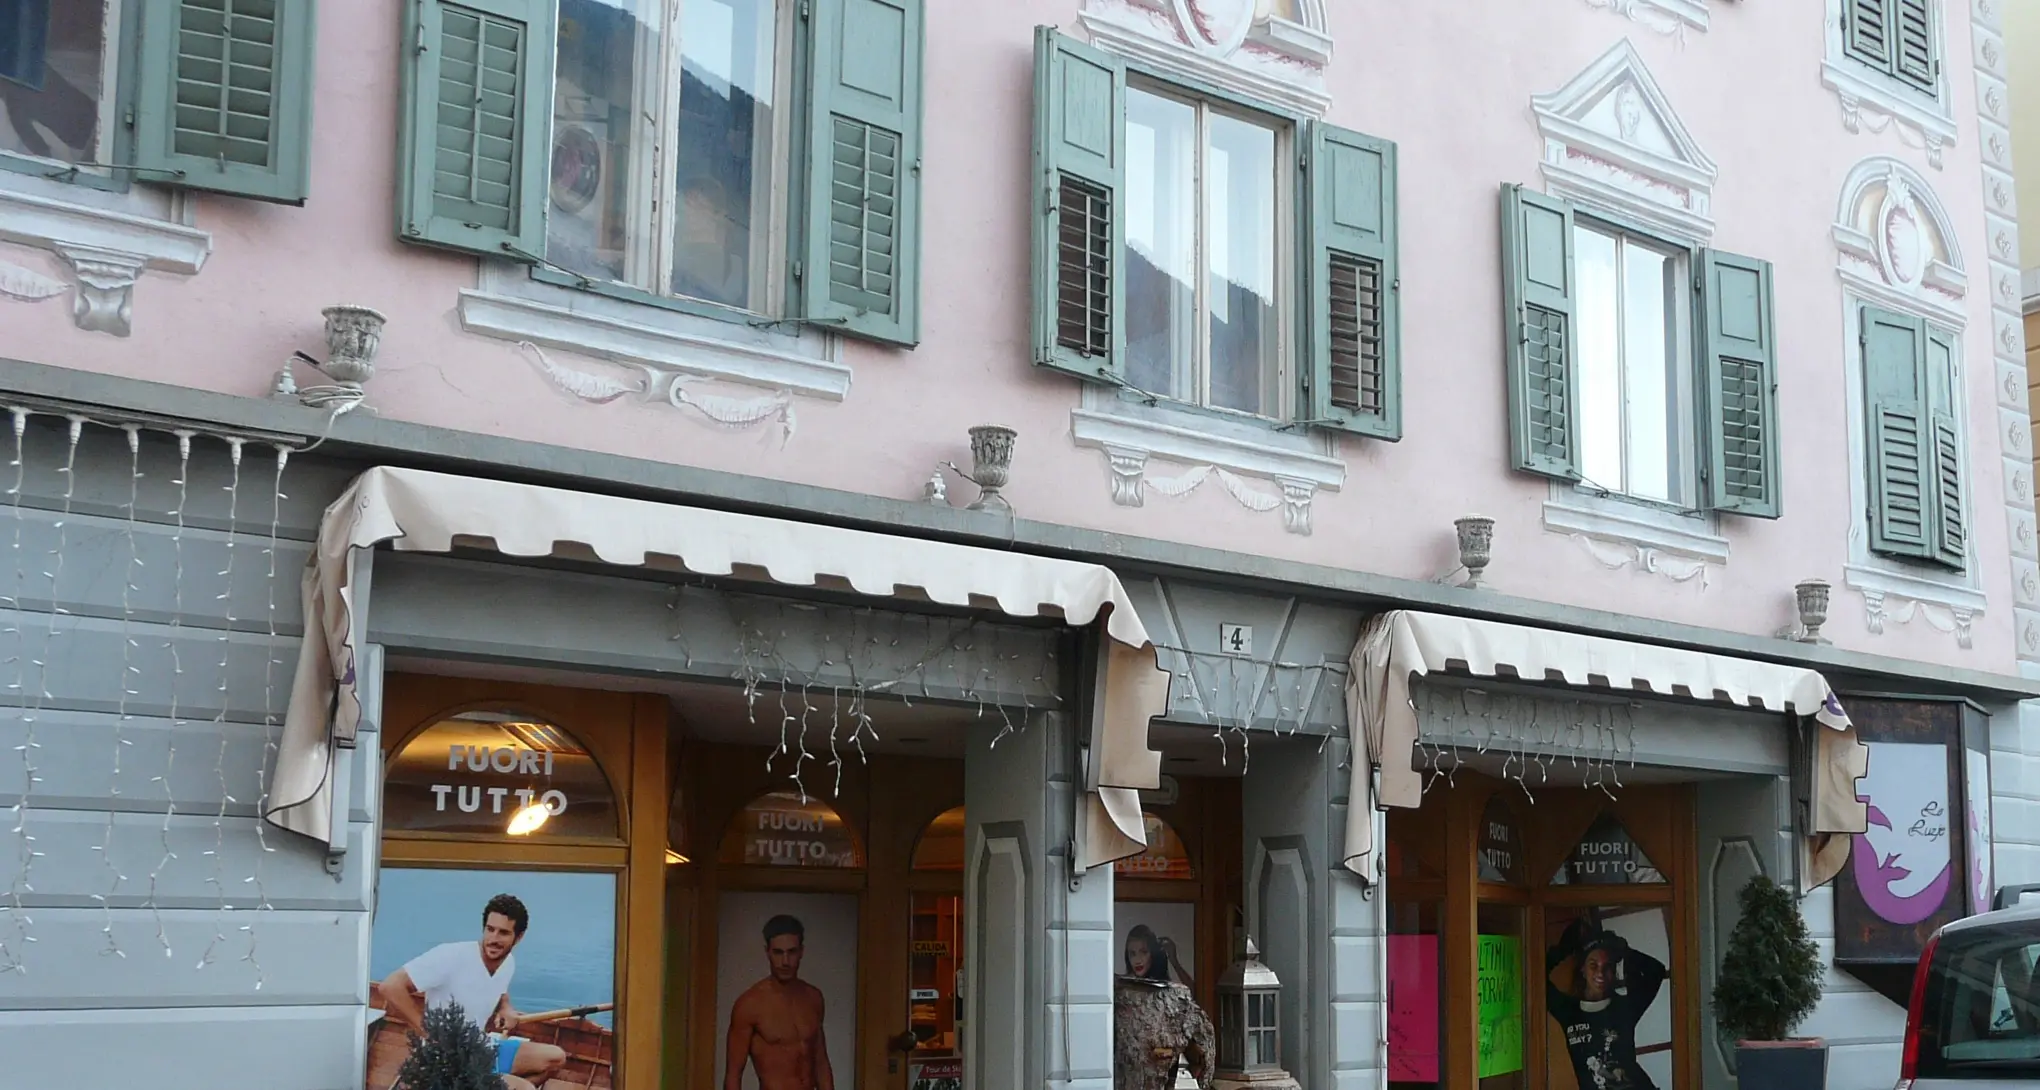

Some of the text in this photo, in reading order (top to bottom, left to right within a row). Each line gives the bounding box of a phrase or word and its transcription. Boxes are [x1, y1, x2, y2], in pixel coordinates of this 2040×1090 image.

[1230, 627, 1244, 651] 4
[448, 744, 554, 775] FUORI
[430, 784, 568, 816] TUTTO
[758, 811, 824, 833] FUORI
[1489, 821, 1509, 843] FUORI
[755, 838, 827, 859] TUTTO
[1487, 848, 1512, 870] TUTTO
[1580, 842, 1629, 856] FUORI
[1574, 859, 1638, 875] TUTTO
[914, 942, 947, 952] CALIDA
[925, 1065, 941, 1074] Tour
